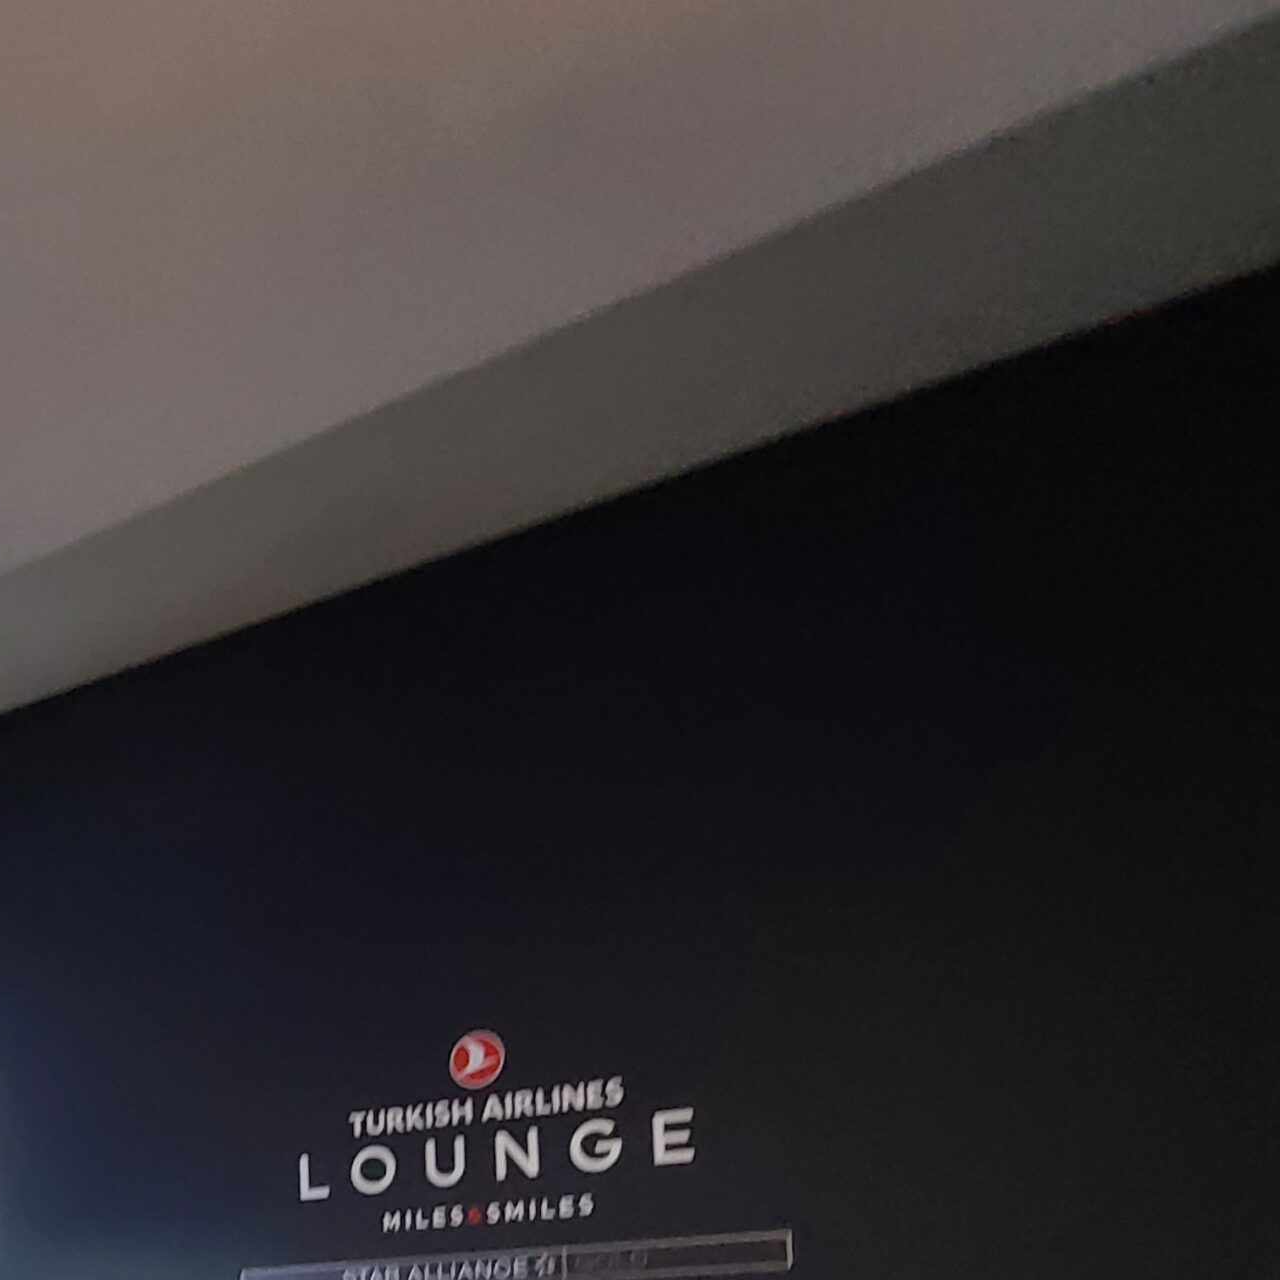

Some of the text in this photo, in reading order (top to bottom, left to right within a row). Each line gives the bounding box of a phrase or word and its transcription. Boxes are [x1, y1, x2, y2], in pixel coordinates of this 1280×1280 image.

[348, 1075, 624, 1139] TURKISH AIRLINES
[298, 1107, 696, 1202] LOUNGE
